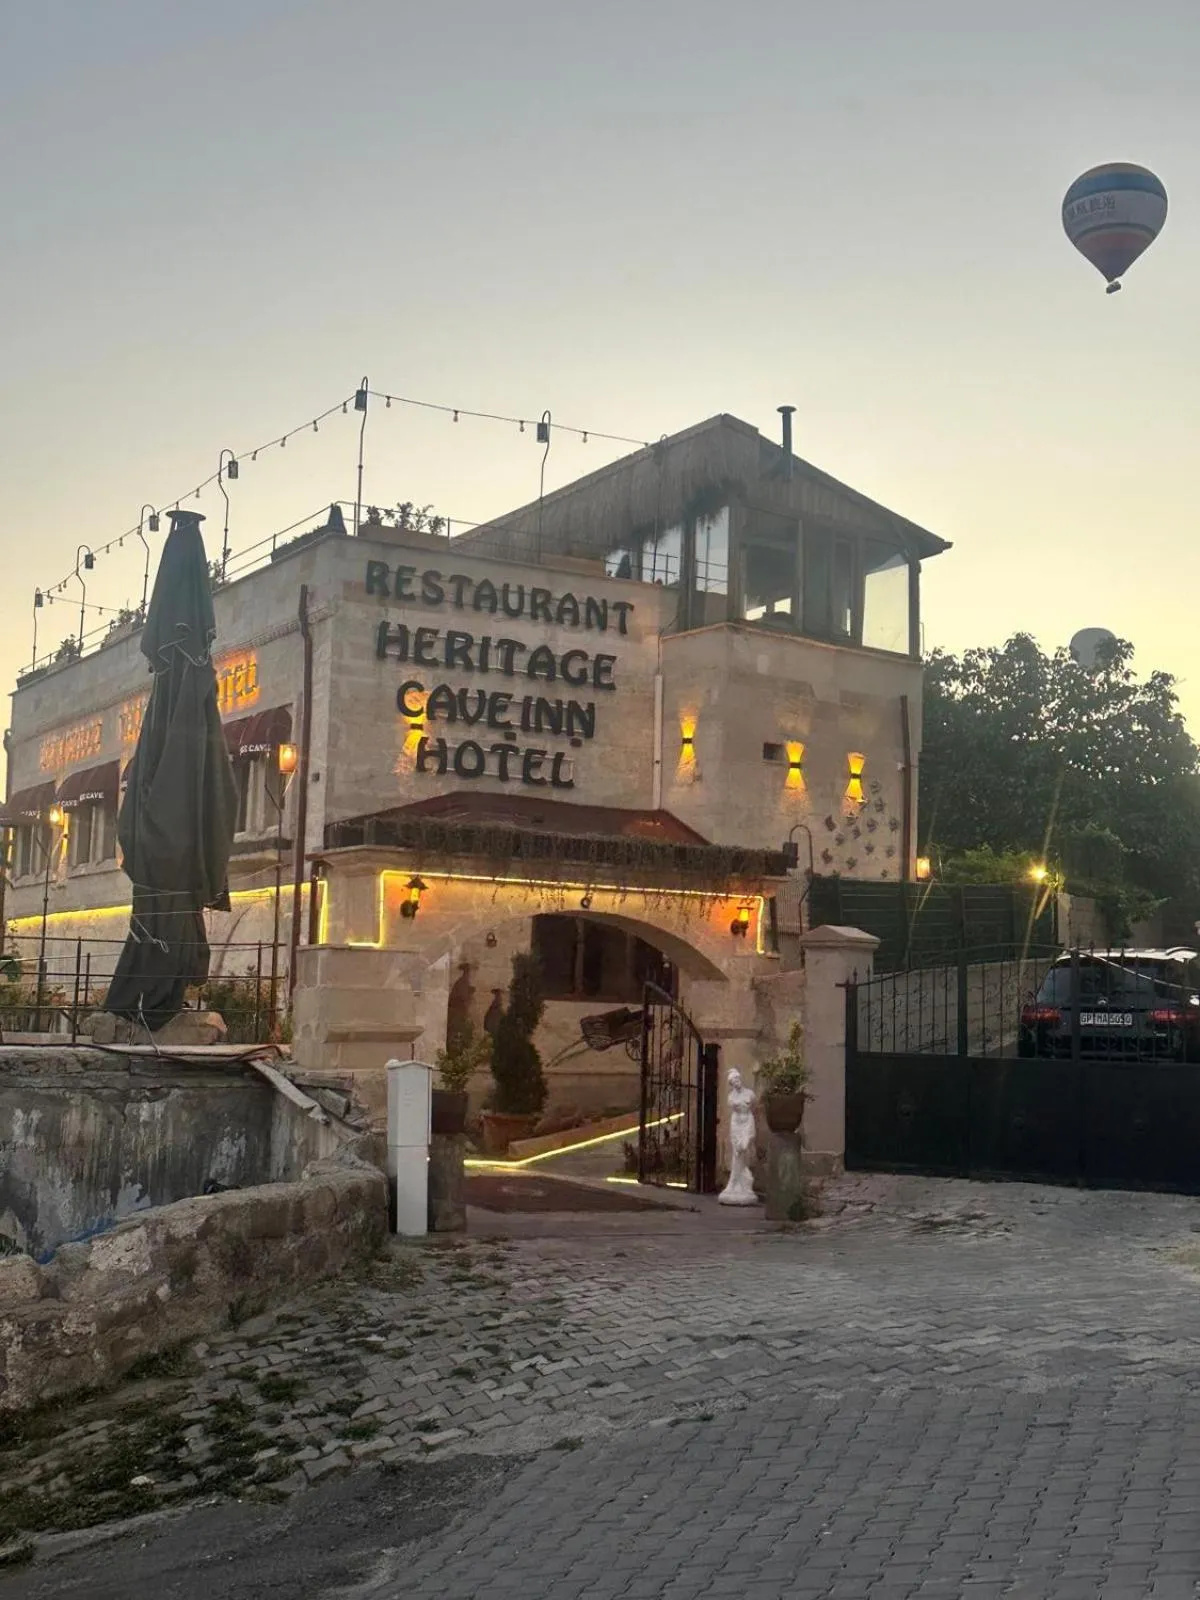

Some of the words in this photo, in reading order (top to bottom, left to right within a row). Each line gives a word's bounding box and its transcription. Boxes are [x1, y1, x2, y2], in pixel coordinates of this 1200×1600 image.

[365, 560, 634, 635] RESTAURANT
[376, 620, 617, 690] HERITAGE
[397, 680, 514, 730] CAVE
[519, 694, 596, 739] INN
[416, 736, 575, 788] HOTEL
